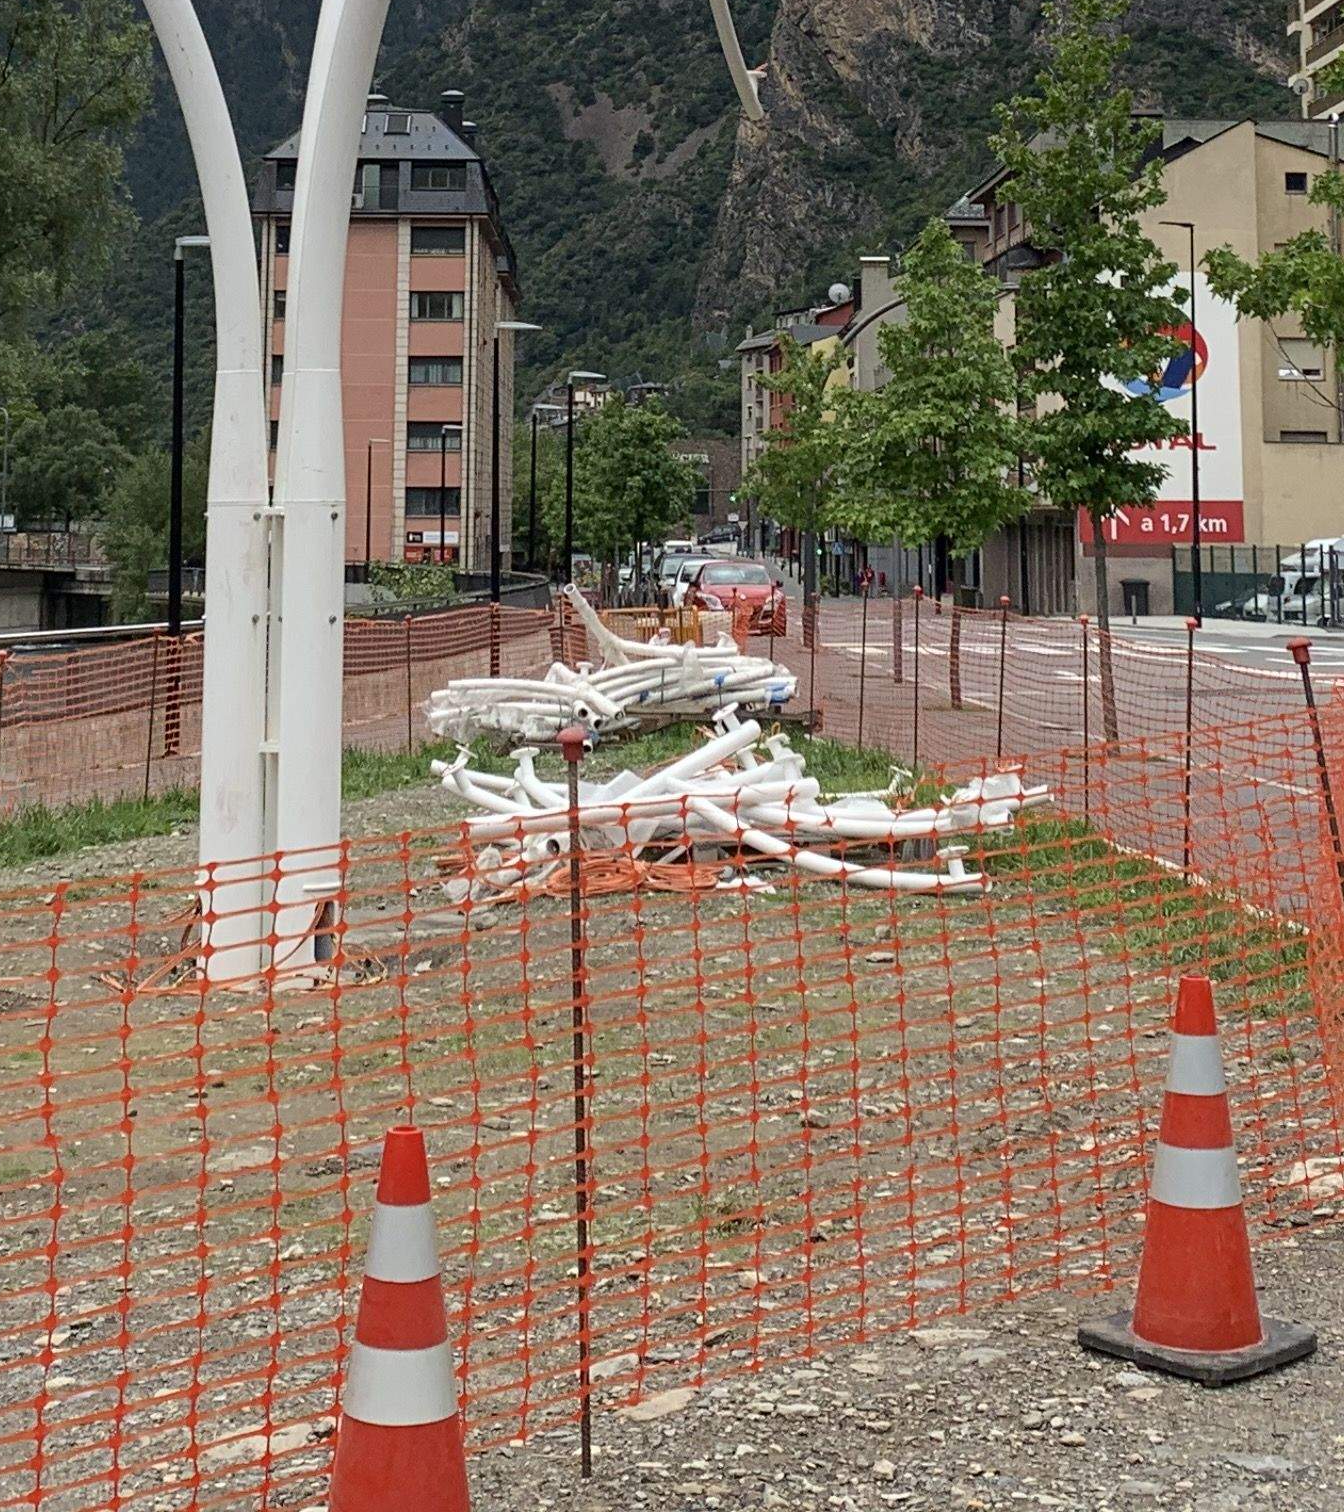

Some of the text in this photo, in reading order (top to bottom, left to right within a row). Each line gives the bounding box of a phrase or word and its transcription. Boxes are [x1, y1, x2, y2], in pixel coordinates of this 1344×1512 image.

[1141, 514, 1228, 534] a 1,7 km
